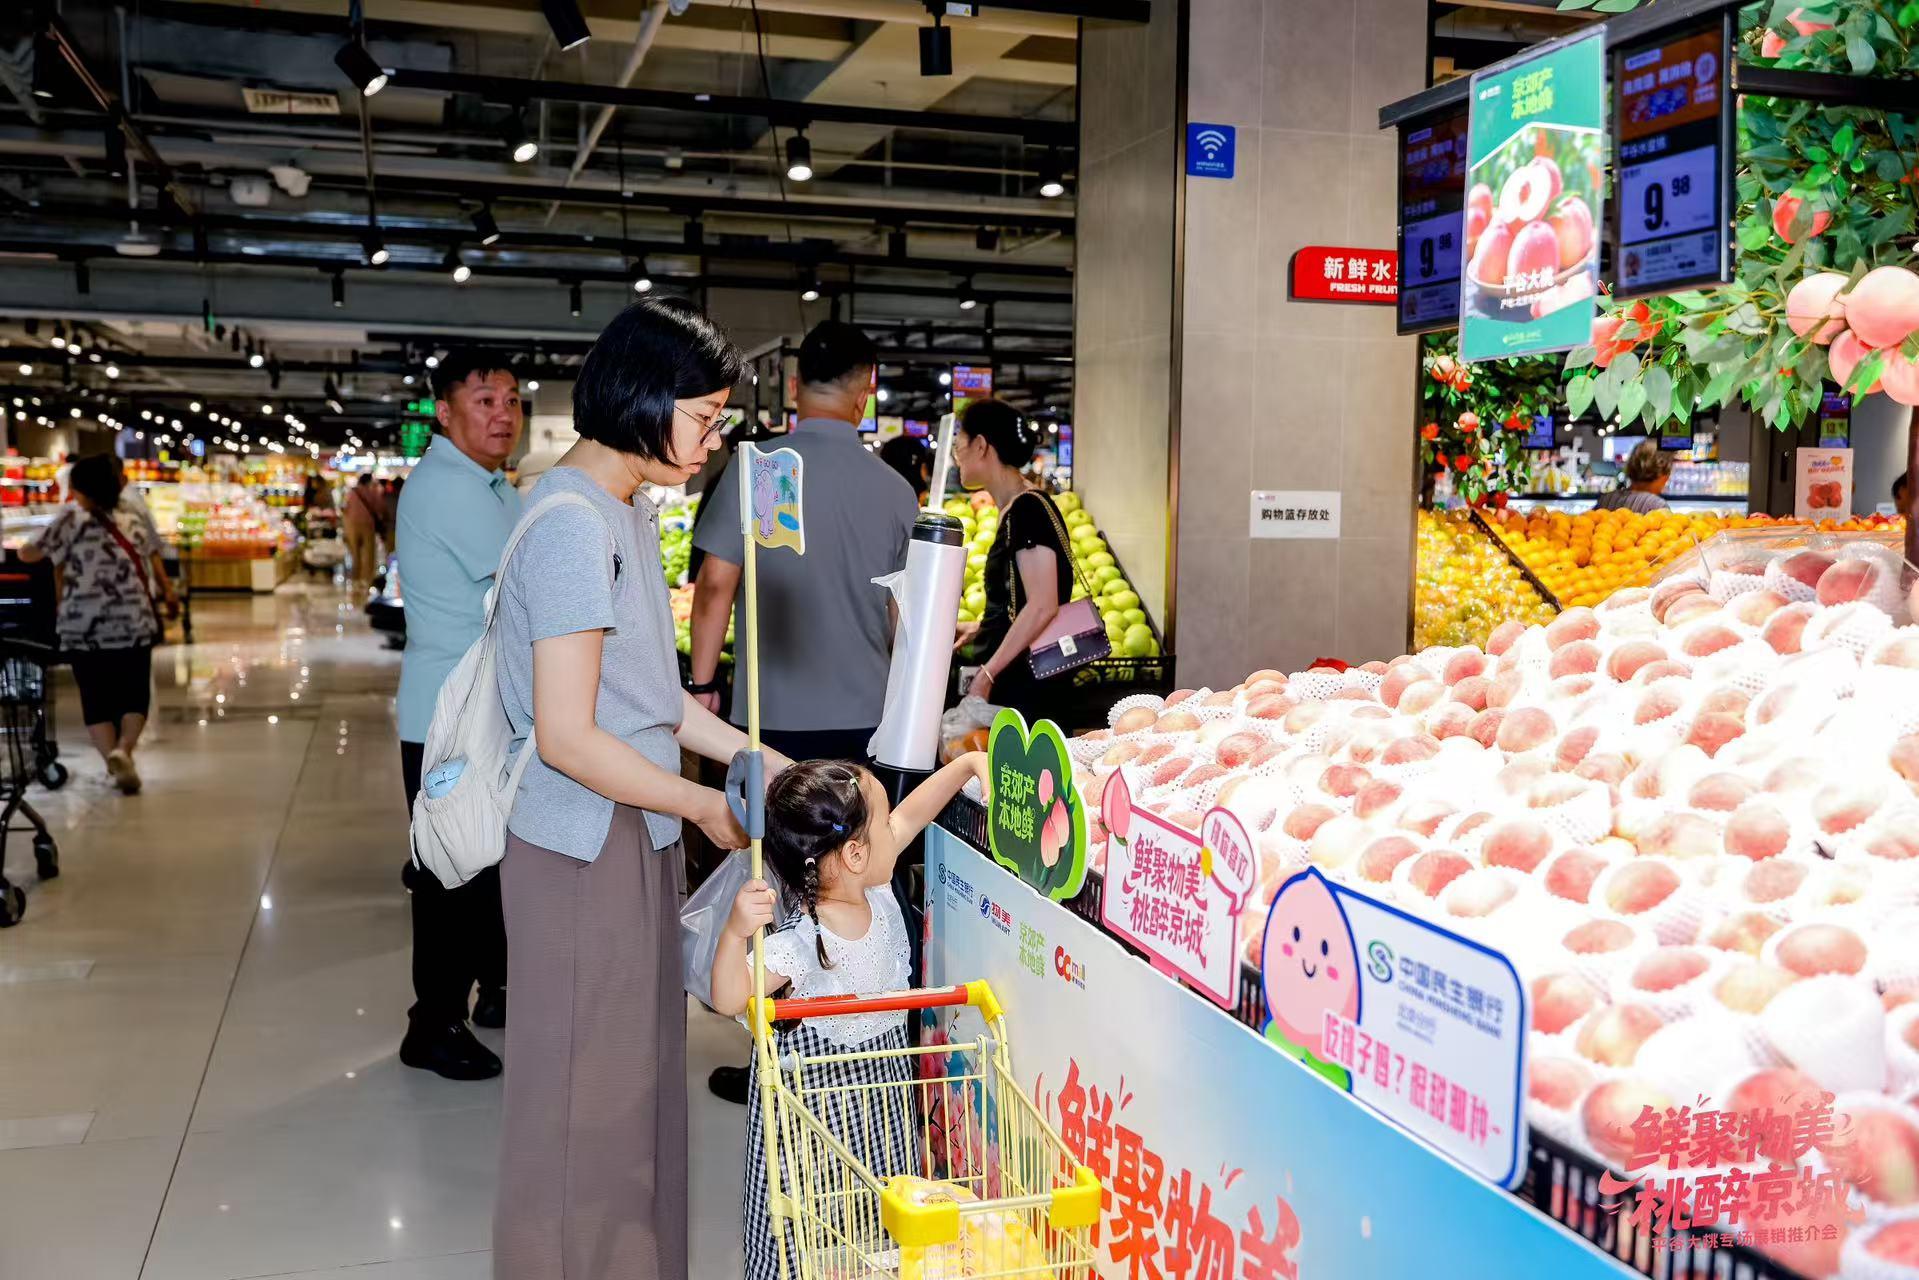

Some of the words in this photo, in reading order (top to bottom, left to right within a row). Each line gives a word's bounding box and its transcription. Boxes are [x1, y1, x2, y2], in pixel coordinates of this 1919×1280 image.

[1324, 256, 1398, 281] 新鲜水
[1330, 282, 1365, 293] FRESH
[1261, 508, 1330, 521] 购物篮存放处
[1000, 763, 1035, 805] 京郊产
[999, 799, 1035, 843] 本地鲜
[1131, 832, 1208, 911] 鲜聚物美
[991, 902, 1012, 928] 物美
[1130, 890, 1207, 969] 桃醉京城
[1019, 921, 1045, 952] 京郊产
[1019, 945, 1045, 979] 本地鲜
[1398, 955, 1503, 1023] 中国民生银行
